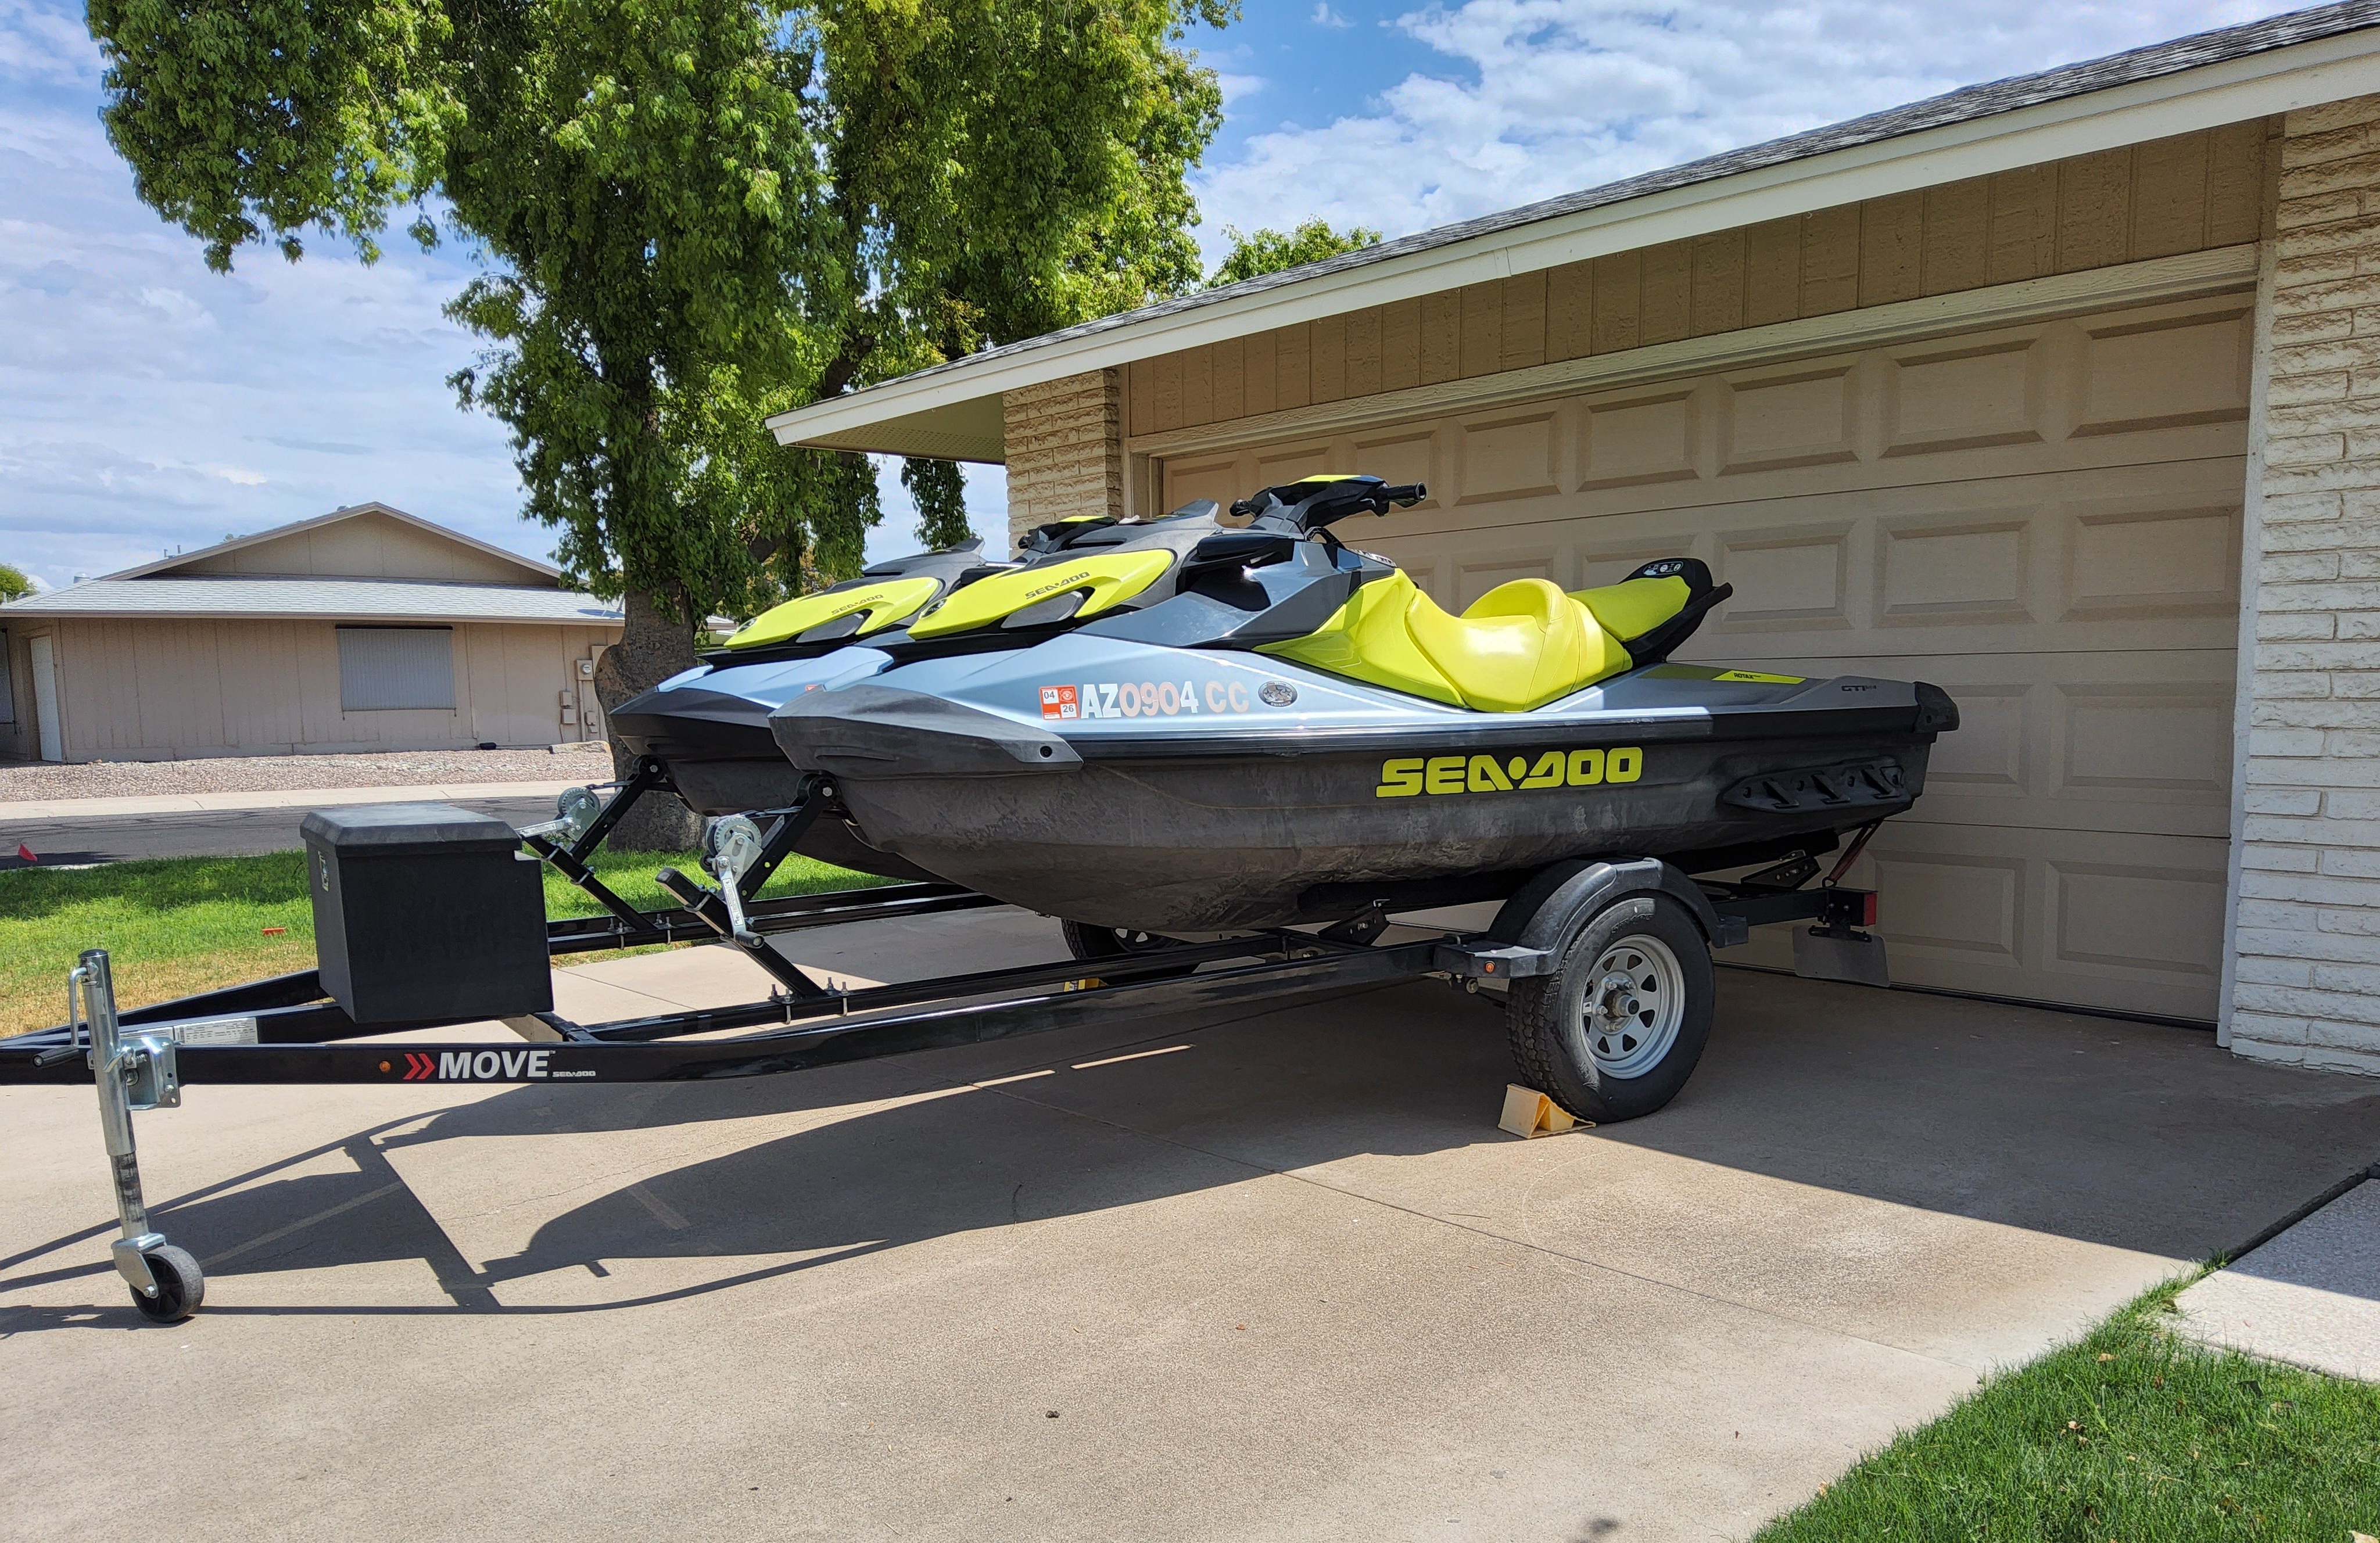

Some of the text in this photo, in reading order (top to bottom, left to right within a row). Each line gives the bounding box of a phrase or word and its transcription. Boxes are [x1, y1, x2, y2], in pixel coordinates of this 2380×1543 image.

[1044, 691, 1055, 699] 04
[1205, 680, 1249, 713] CC
[1062, 705, 1074, 713] 26
[439, 1051, 550, 1079] MOVE
